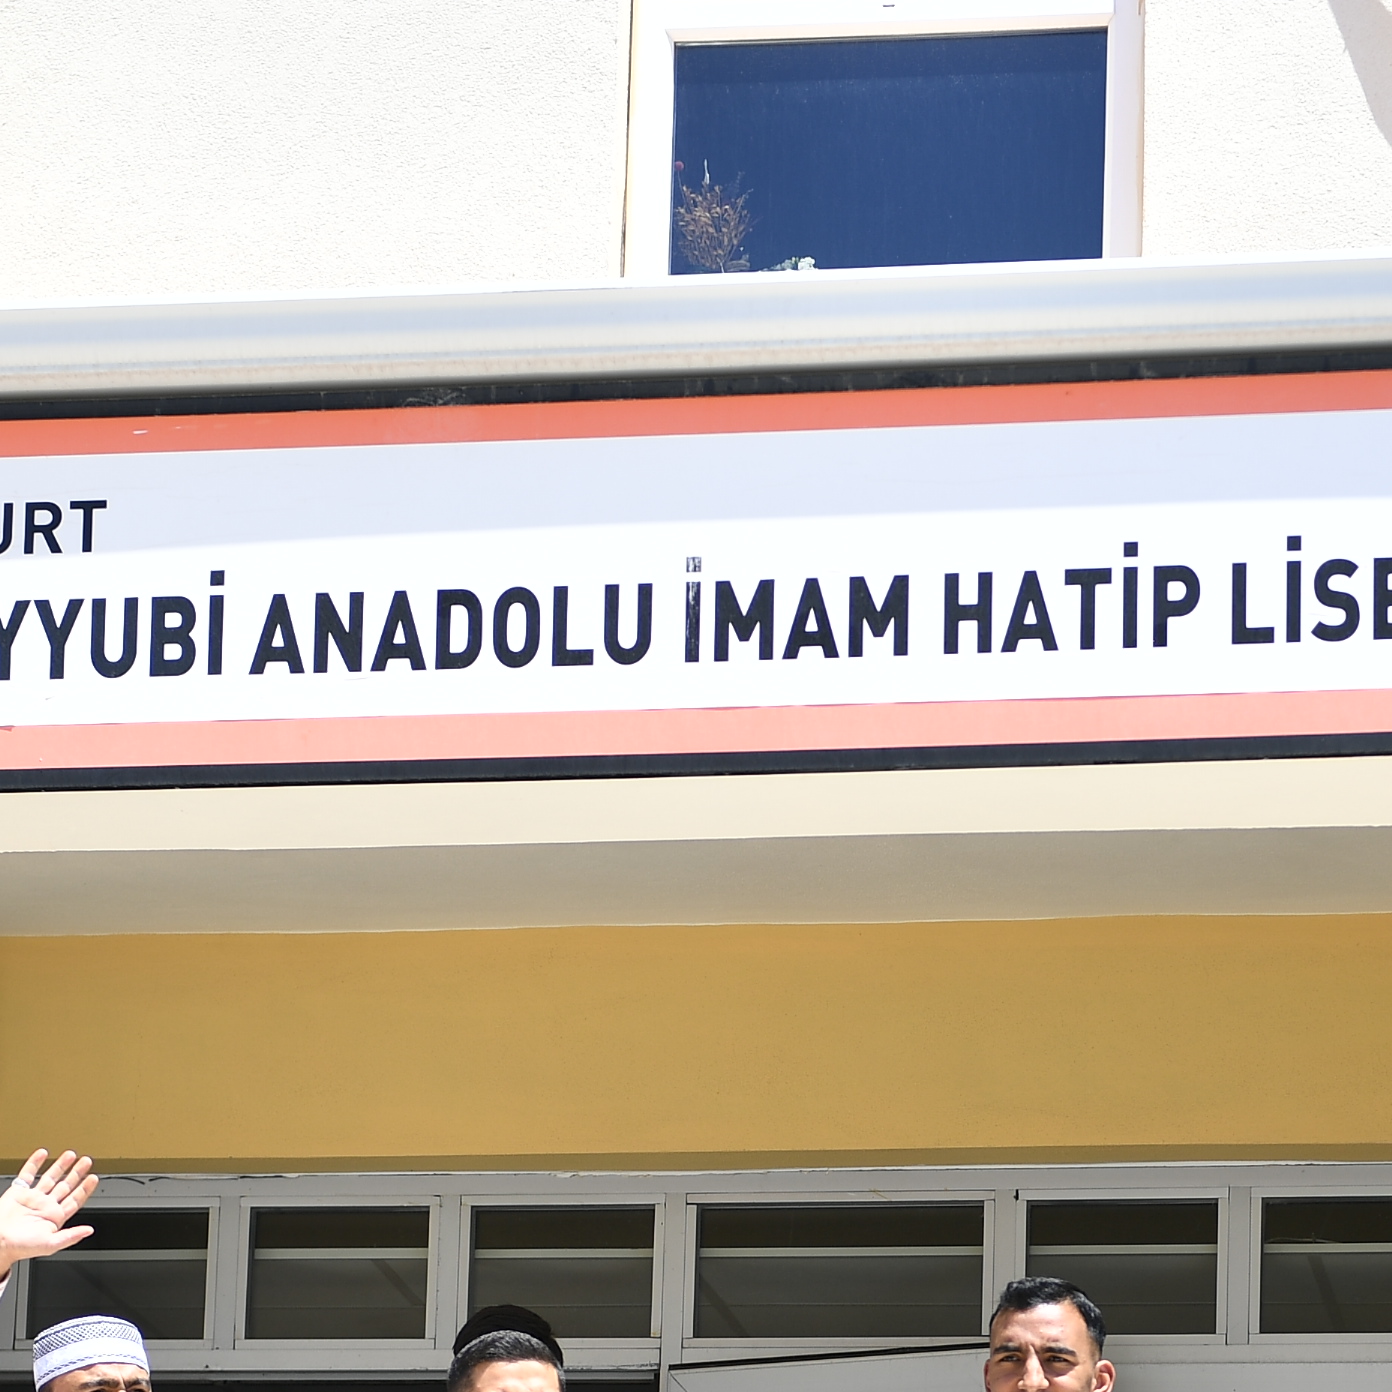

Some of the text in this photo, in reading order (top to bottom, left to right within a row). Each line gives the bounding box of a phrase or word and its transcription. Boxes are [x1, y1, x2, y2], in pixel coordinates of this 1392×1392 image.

[249, 584, 652, 674] ANADOLU
[685, 557, 909, 662] İMAM
[944, 541, 1200, 654] HATİP
